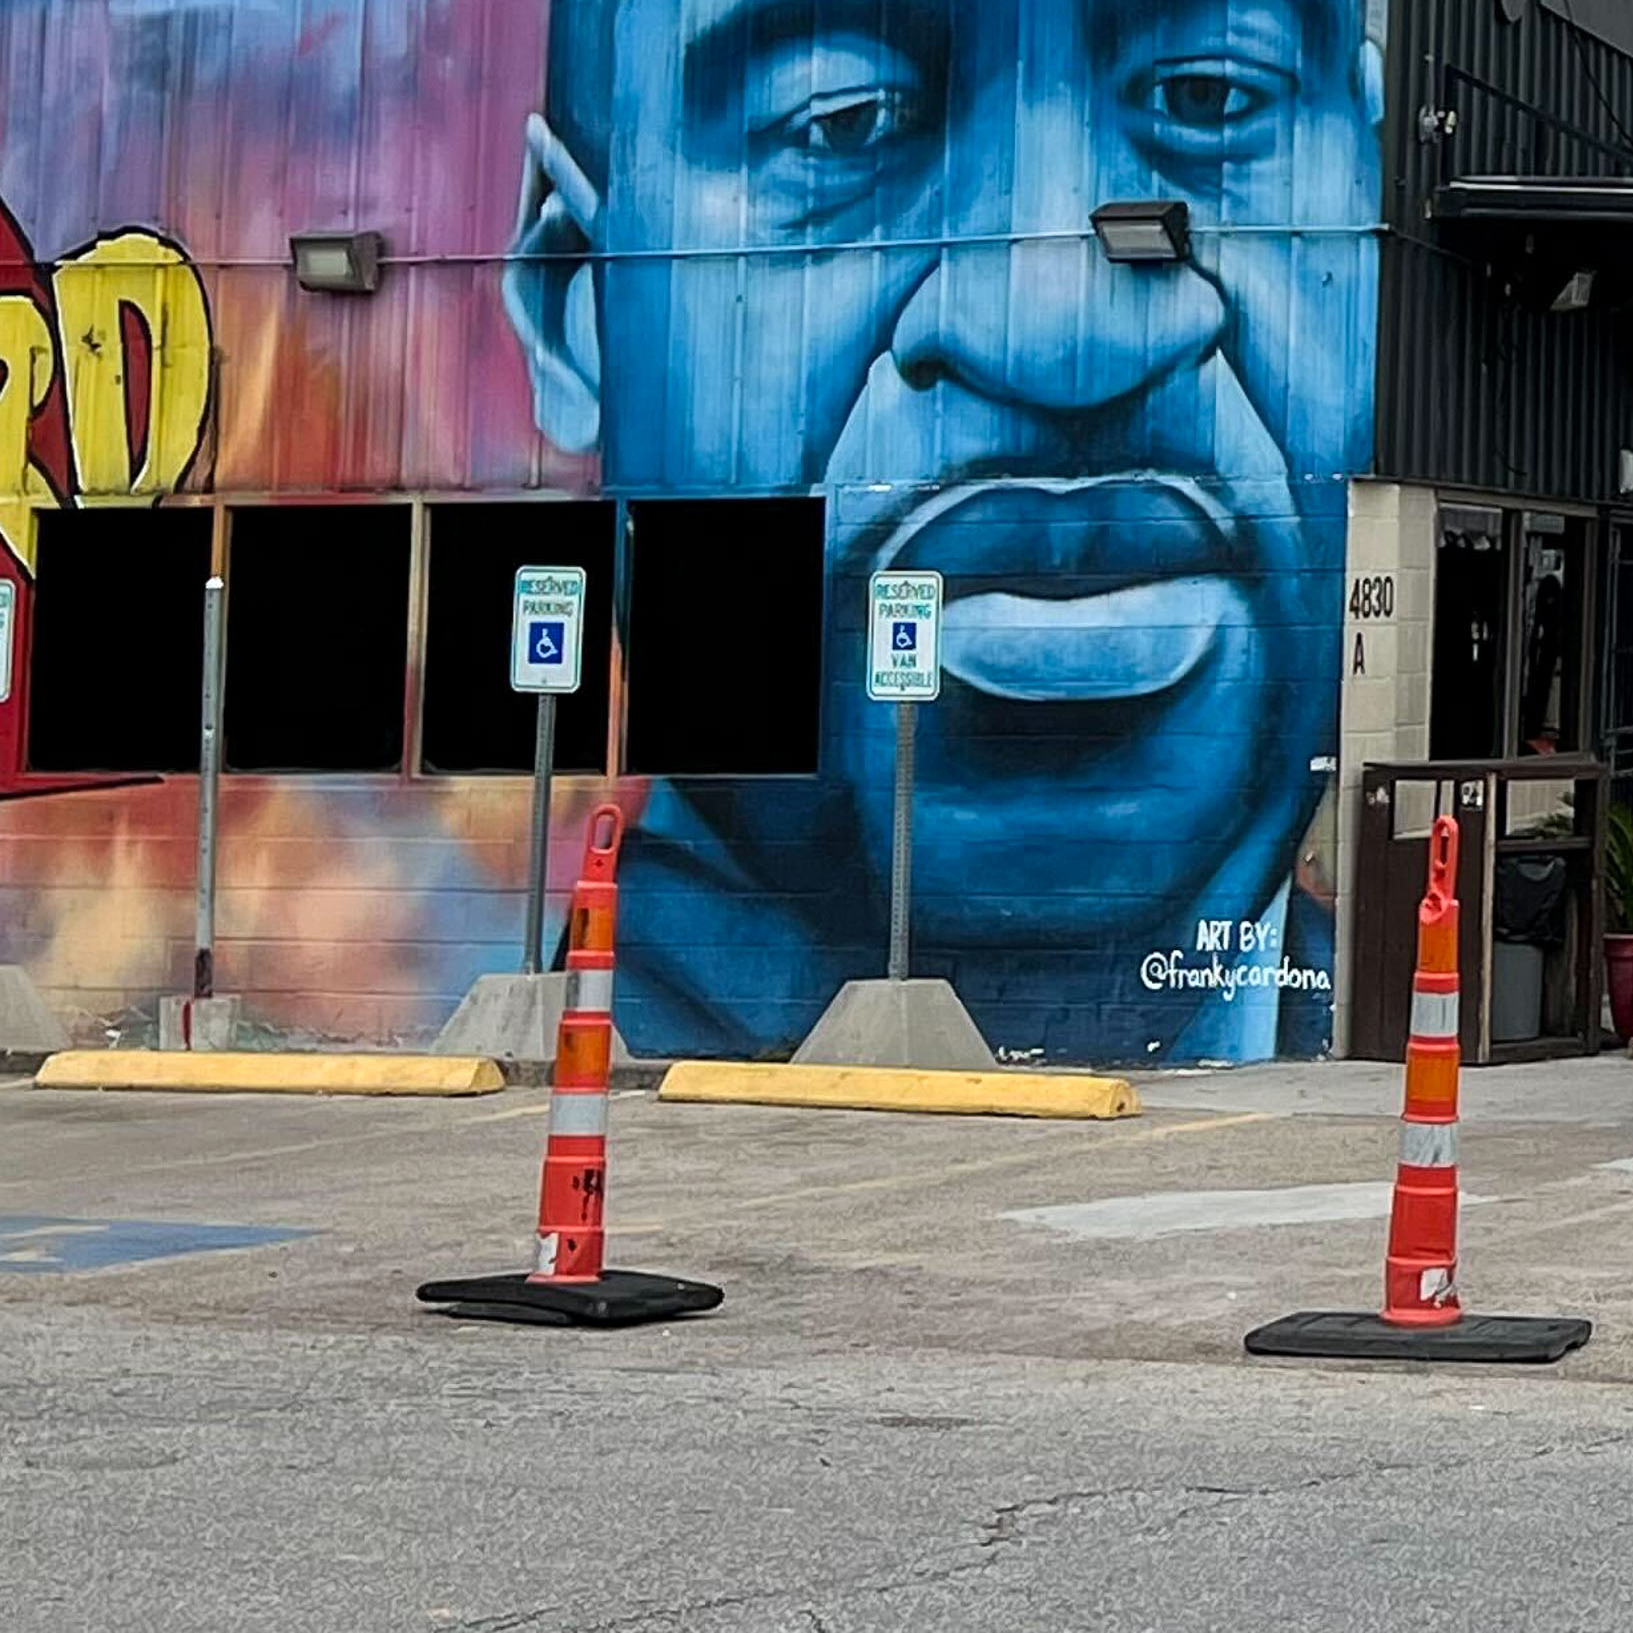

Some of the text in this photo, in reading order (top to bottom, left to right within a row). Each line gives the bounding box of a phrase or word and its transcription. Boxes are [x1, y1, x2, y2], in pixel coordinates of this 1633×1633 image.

[875, 583, 936, 600] RESERVED
[1349, 575, 1394, 620] 4830
[879, 602, 932, 619] PARKING
[891, 652, 917, 668] VAN
[1353, 632, 1366, 675] A
[874, 670, 932, 687] ACCESSIBLE
[1196, 918, 1279, 953] ART BY:
[1140, 950, 1331, 1001] @frankycardona
